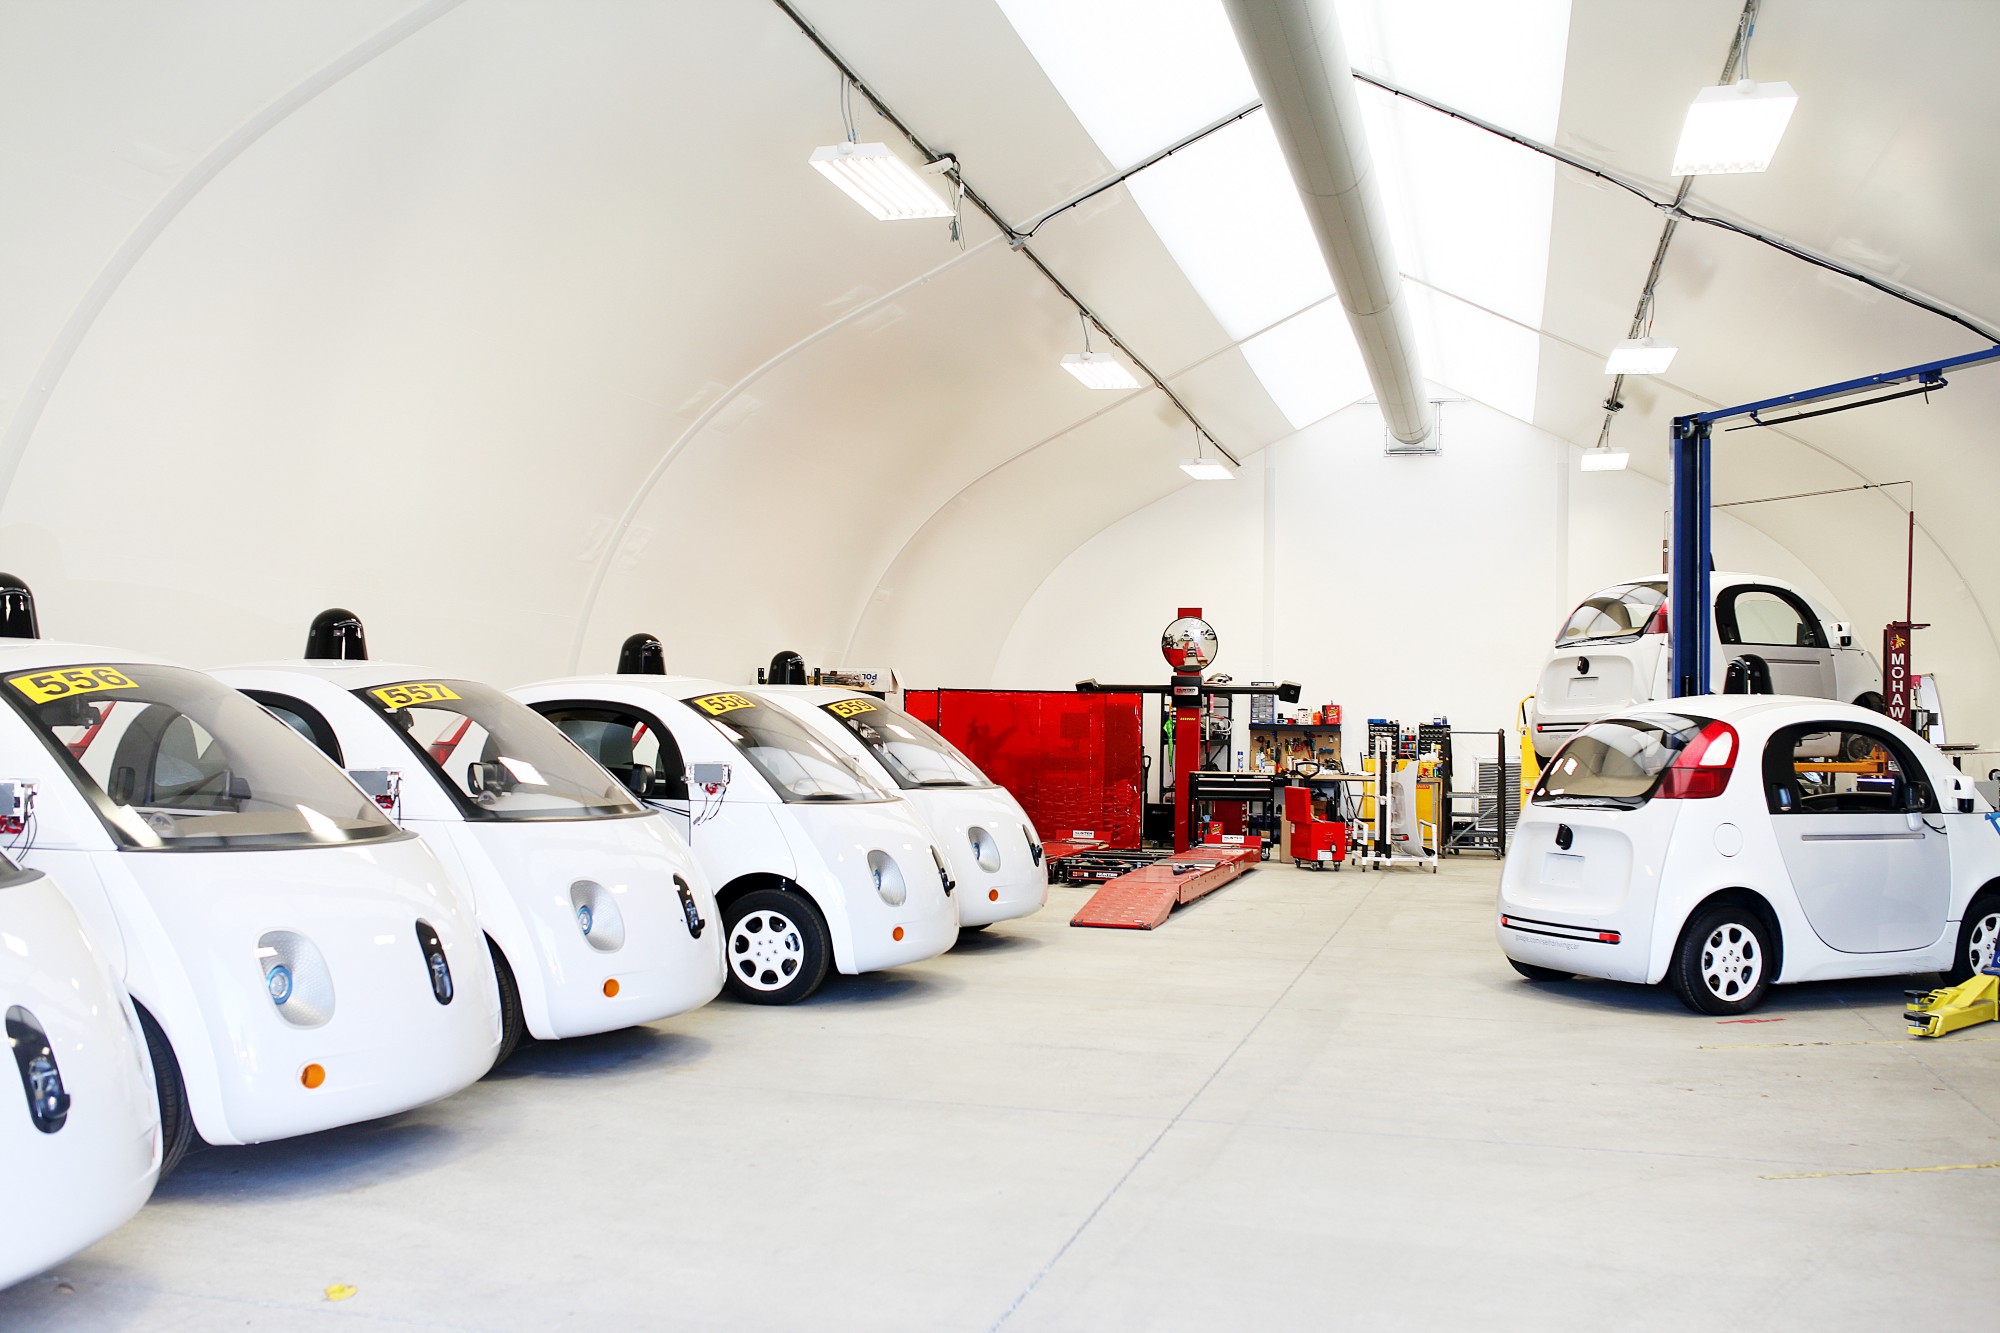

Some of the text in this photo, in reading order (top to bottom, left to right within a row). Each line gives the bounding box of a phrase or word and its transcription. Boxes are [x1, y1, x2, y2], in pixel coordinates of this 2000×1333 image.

[30, 668, 128, 695] 556
[1889, 653, 1905, 724] MOHAW
[383, 684, 448, 704] 557
[839, 700, 872, 715] 559
